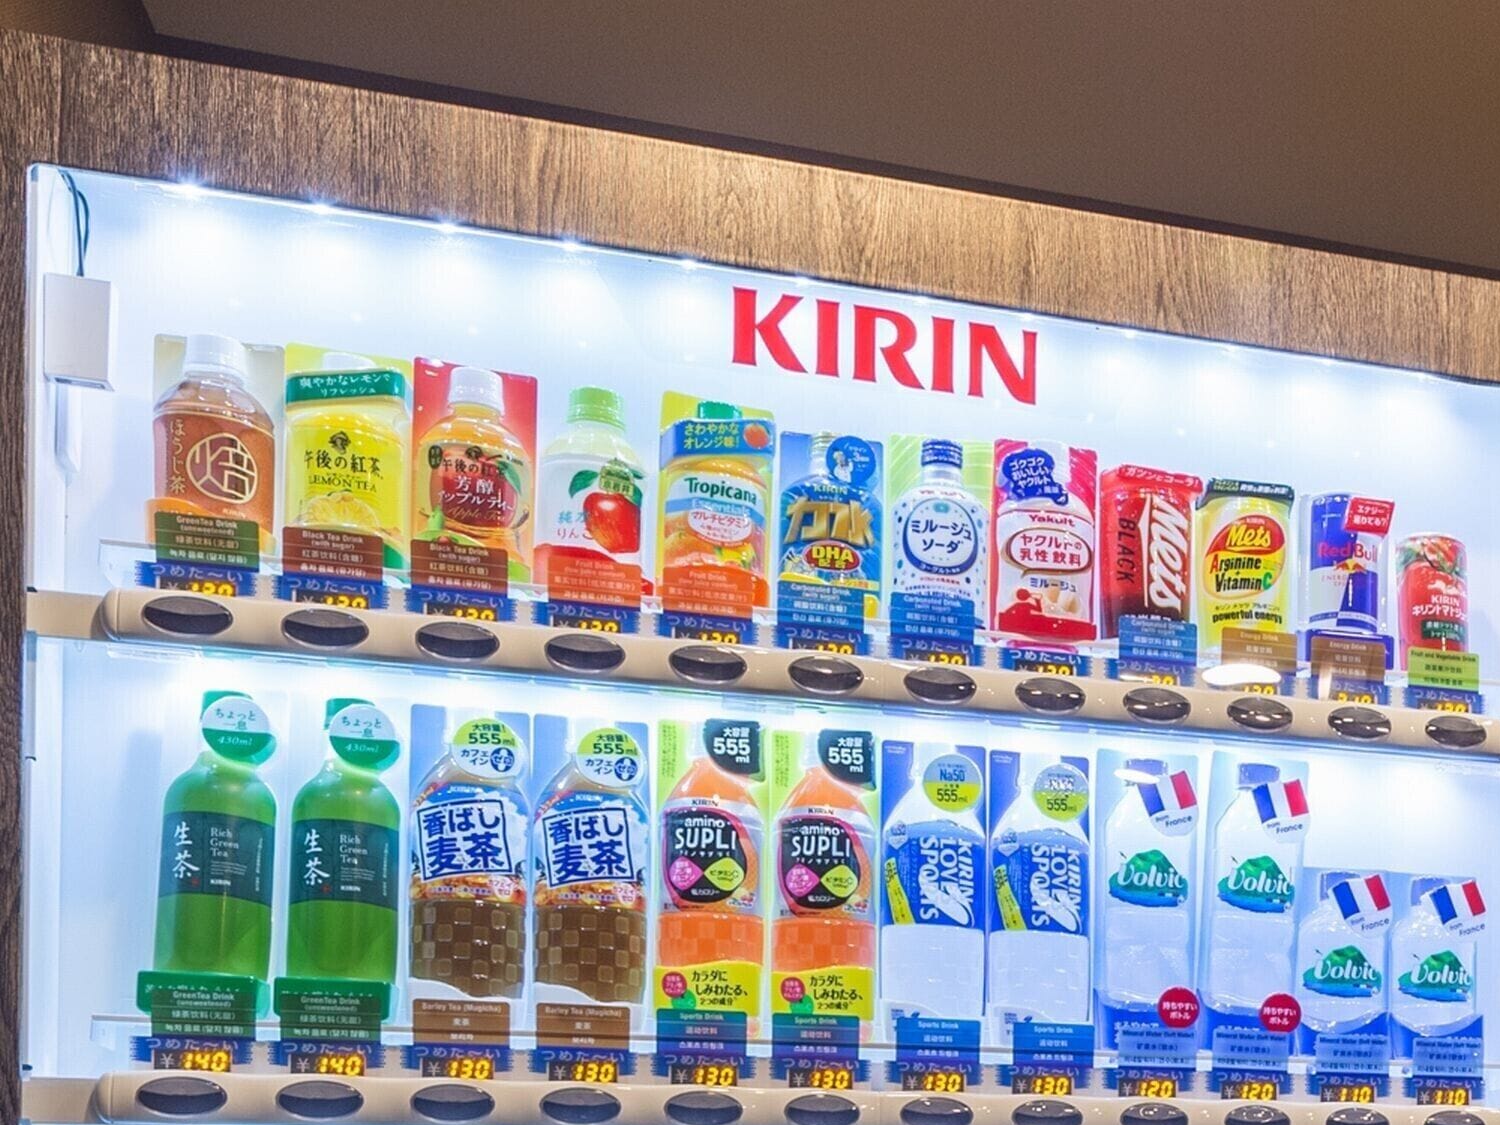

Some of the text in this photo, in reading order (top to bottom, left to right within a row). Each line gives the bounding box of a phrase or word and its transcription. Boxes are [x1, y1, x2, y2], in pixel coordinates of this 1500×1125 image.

[732, 286, 1038, 405] KIRIN
[684, 422, 739, 436] さわやかな
[168, 418, 187, 494] ほうじ茶
[304, 449, 382, 476] 午後の紅茶
[1011, 467, 1049, 479] おいしい
[308, 476, 349, 491] LEMON
[684, 478, 757, 505] Tropicana
[1029, 513, 1076, 528] Yakult
[911, 520, 973, 542] ミルージュ
[1226, 524, 1272, 548] Mets
[811, 544, 854, 563] DHA
[921, 538, 963, 555] ソーダ
[1117, 517, 1136, 583] BLACK
[1149, 494, 1188, 613] Mets
[1319, 543, 1351, 558] Red
[1210, 554, 1261, 573] Arginine
[1213, 611, 1253, 623] powerful
[215, 706, 256, 721] ちょっと
[217, 735, 253, 747] 430ml
[713, 737, 750, 755] 555
[423, 807, 502, 834] 香ばし
[549, 816, 625, 843] 香ばし
[685, 816, 725, 829] amino
[1165, 814, 1192, 828] France
[210, 827, 233, 838] Rich
[675, 828, 736, 851] SUPLI
[172, 823, 199, 879] 生茶
[210, 838, 240, 850] Green
[210, 848, 229, 858] Tea
[425, 832, 504, 875] 麦茶
[791, 835, 851, 858] SUPLI
[552, 840, 626, 881] 麦茶
[1117, 862, 1185, 890] Volvic
[1228, 869, 1295, 896] Volvic
[691, 971, 728, 984] カラダに
[181, 1051, 227, 1071] 140
[317, 1055, 362, 1076] 140
[447, 1060, 489, 1079] 130
[572, 1063, 614, 1082] 130
[693, 1067, 733, 1087] 130
[811, 1070, 849, 1089] 130
[1140, 1080, 1173, 1098] 120
[1338, 1086, 1371, 1103] 110
